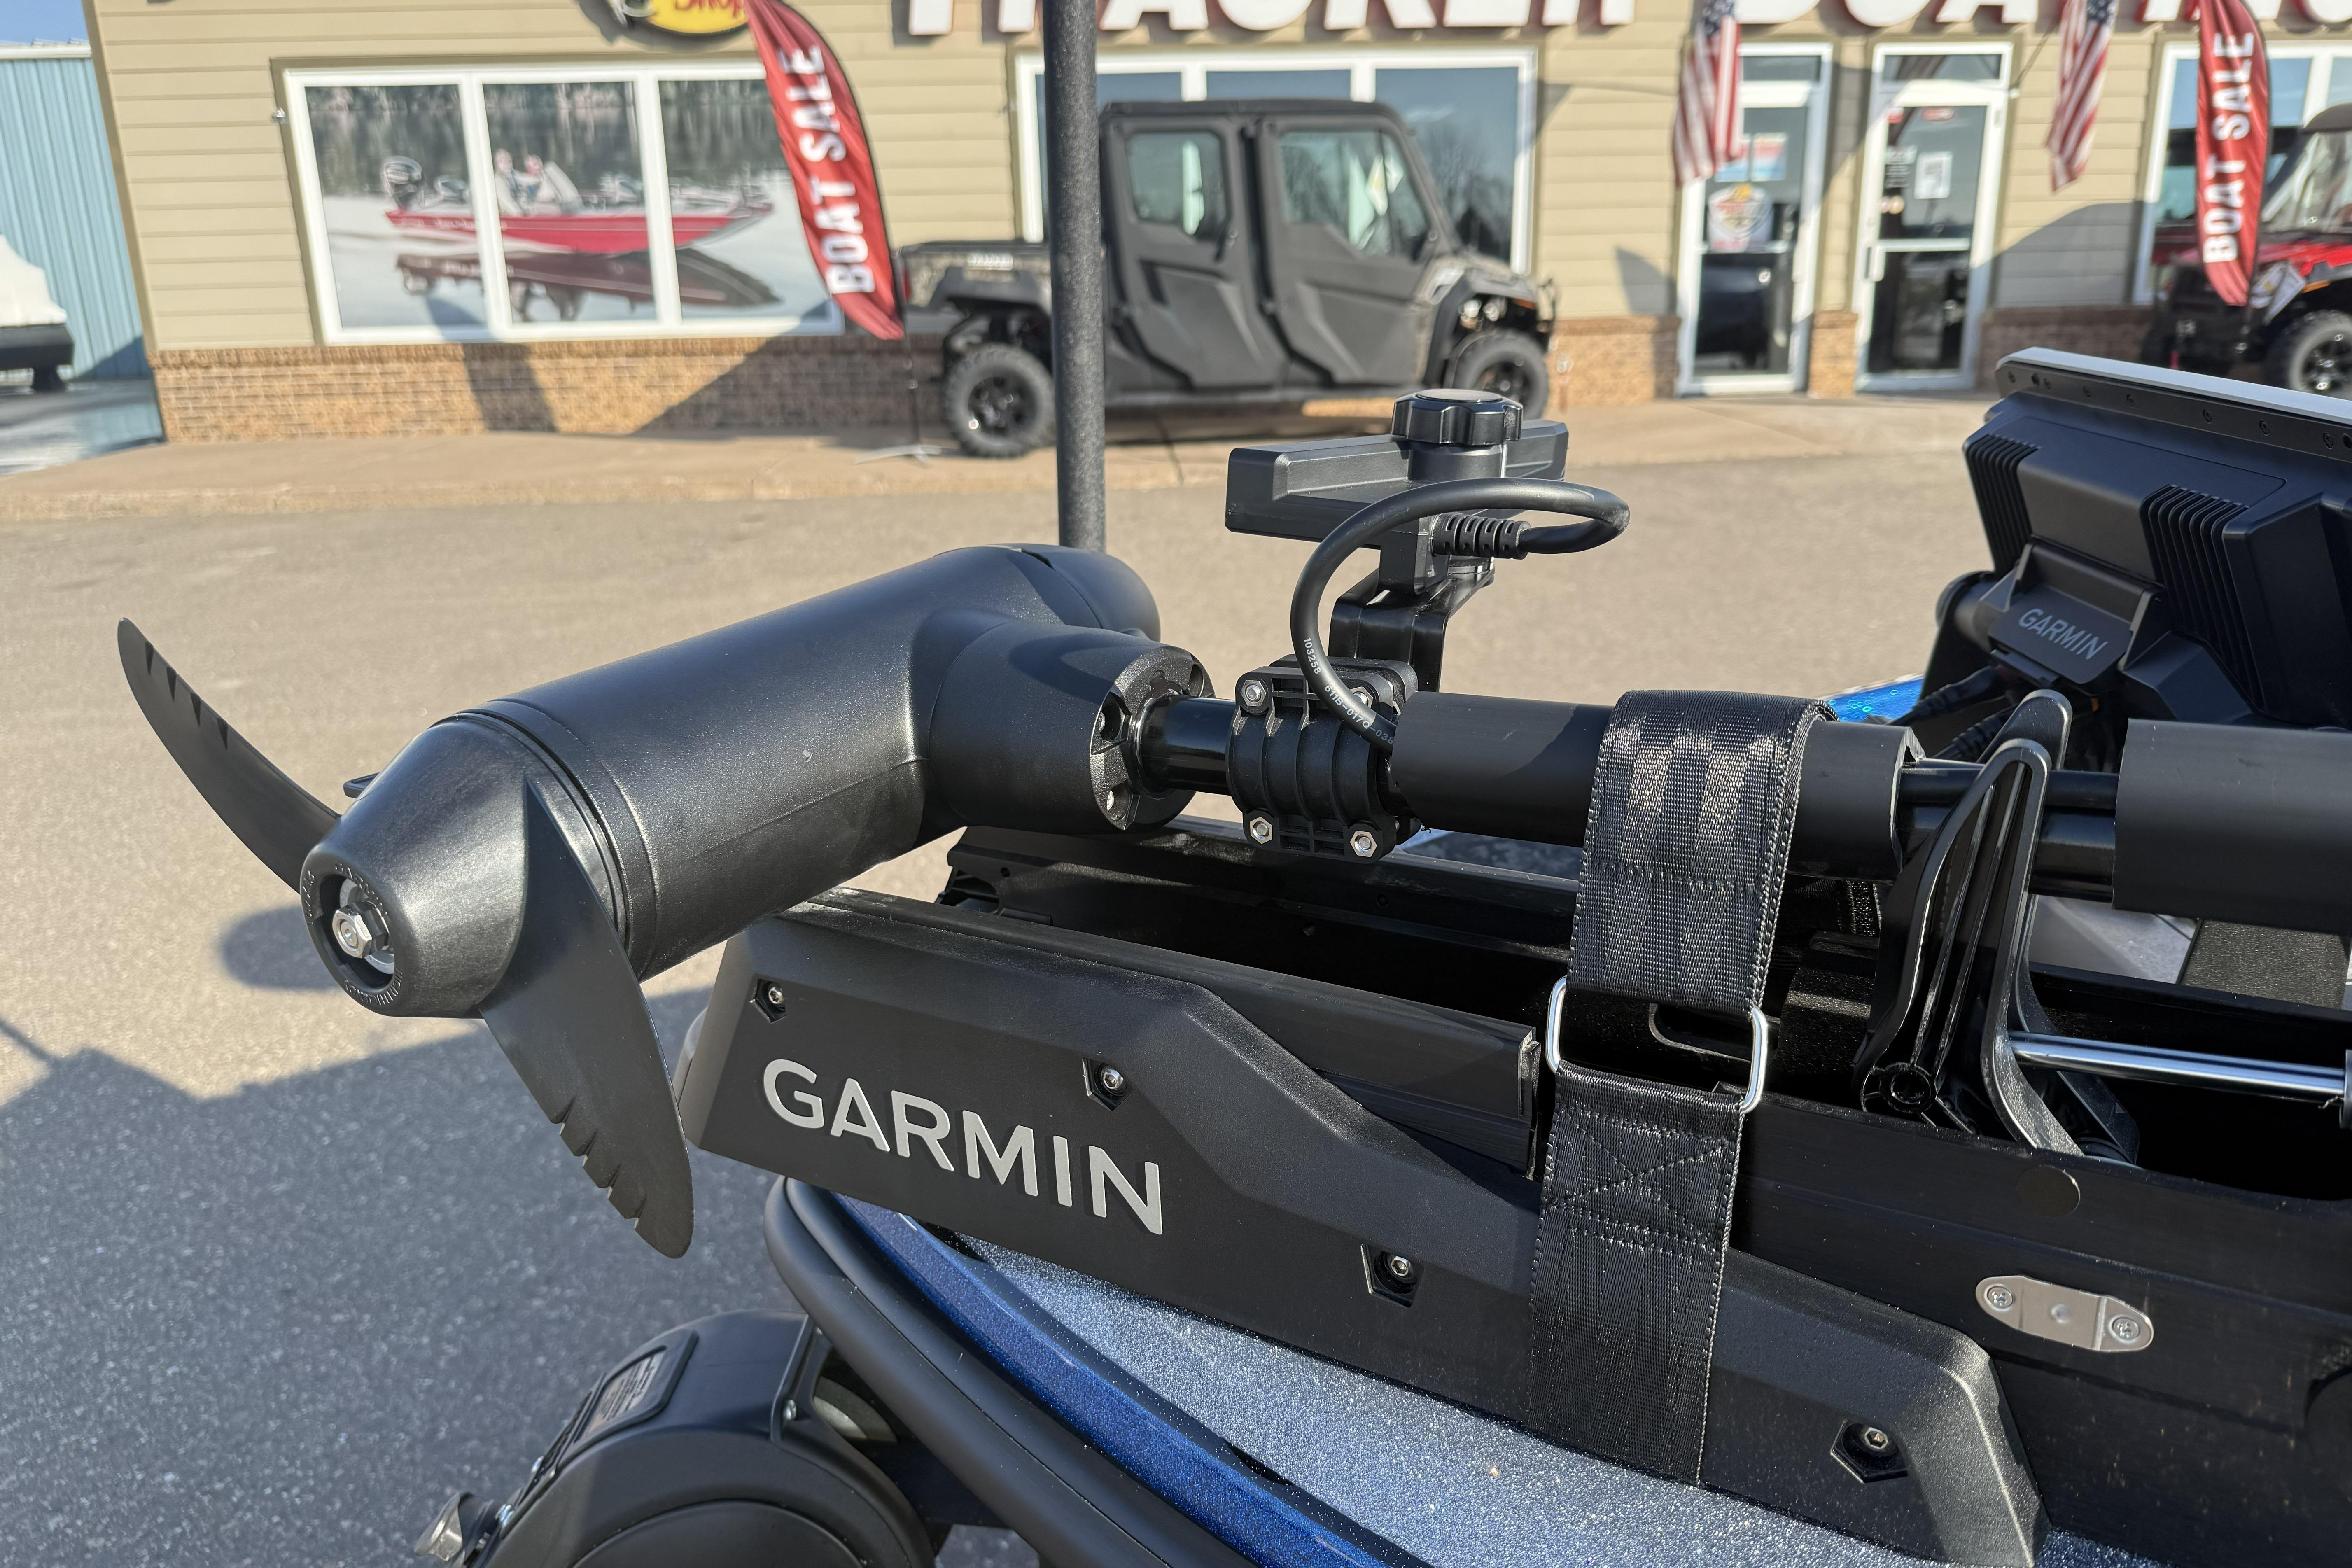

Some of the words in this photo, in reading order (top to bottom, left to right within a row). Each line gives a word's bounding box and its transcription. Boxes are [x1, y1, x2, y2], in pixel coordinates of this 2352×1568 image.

[777, 45, 847, 162] SALE
[2212, 32, 2256, 140] SALE
[809, 175, 876, 294] BOAT
[2202, 155, 2246, 264] BOAT
[1304, 637, 1321, 674] 103258
[2018, 608, 2108, 660] GARMIN
[763, 1059, 1163, 1235] GARMIN
